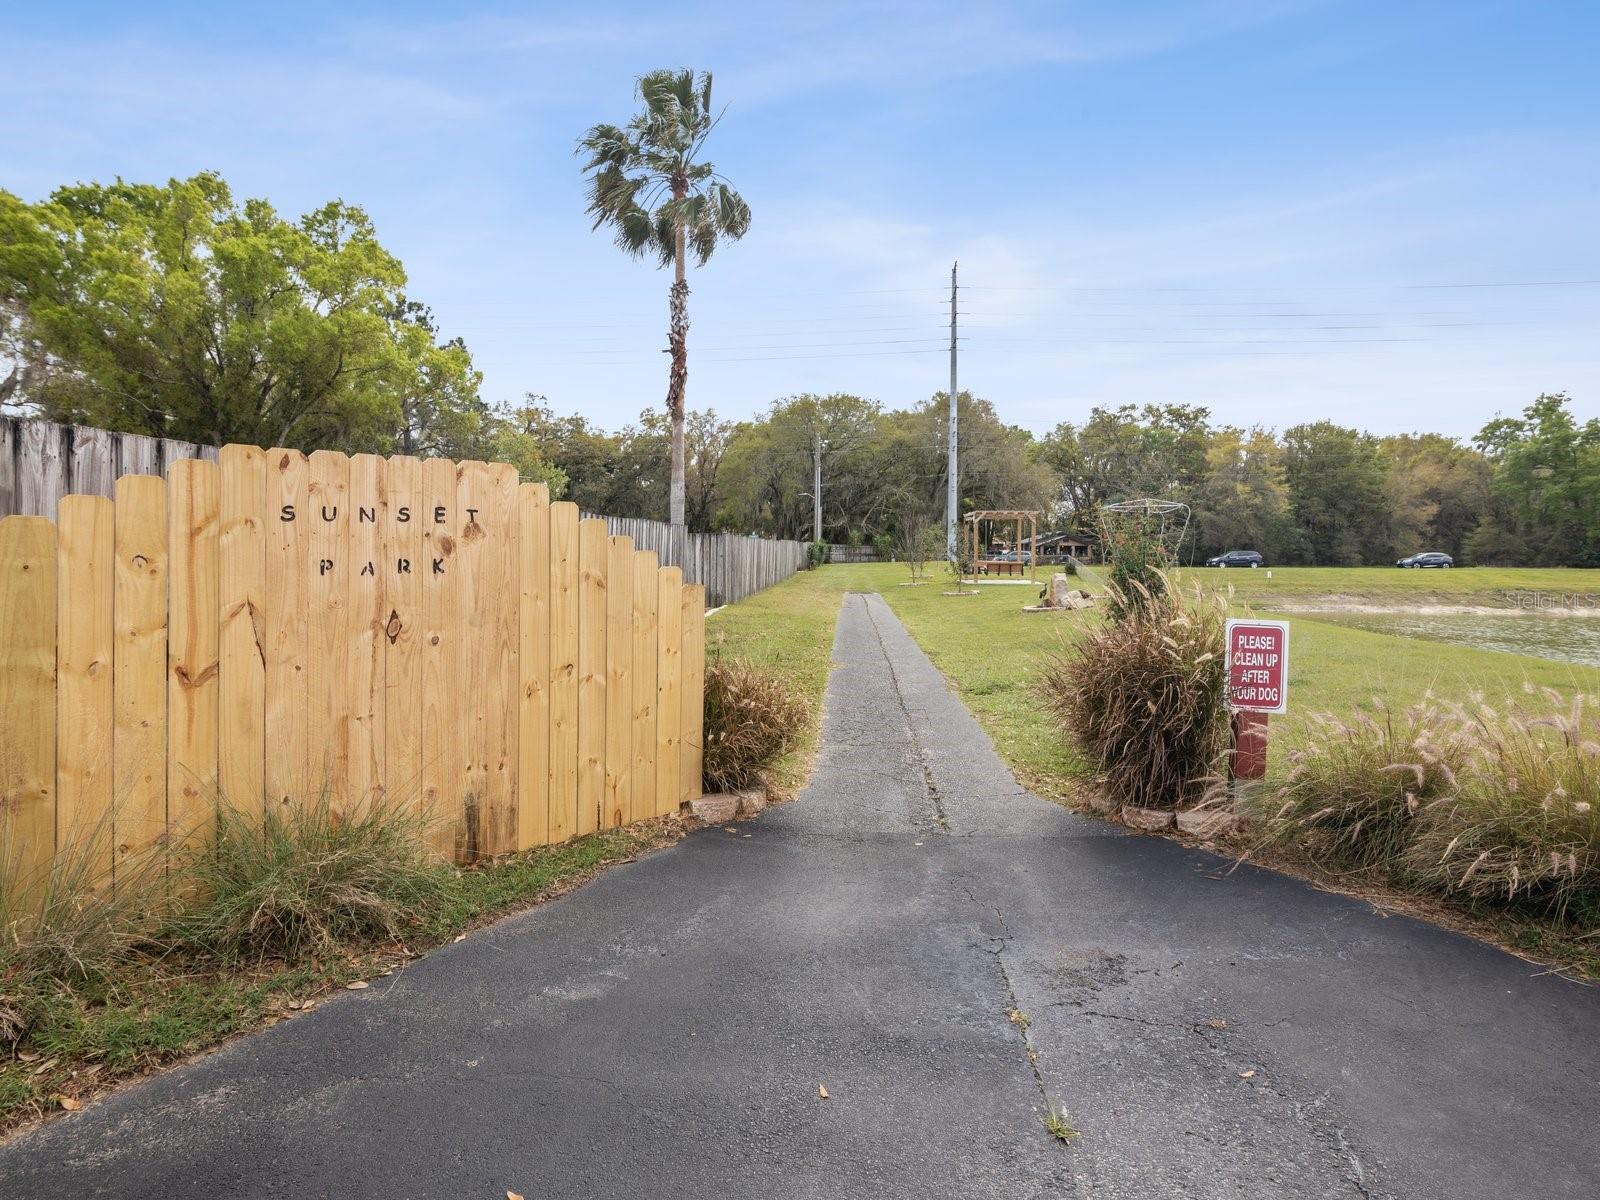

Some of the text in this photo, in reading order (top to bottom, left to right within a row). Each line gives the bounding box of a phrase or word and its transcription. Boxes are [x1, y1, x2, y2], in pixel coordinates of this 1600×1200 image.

[280, 505, 478, 523] SUNSET
[320, 558, 445, 576] PARK
[1239, 635, 1275, 649] PLEASE!
[1234, 652, 1278, 667] CLEAN UP
[1241, 670, 1269, 683] AFTER
[1258, 687, 1278, 701] DOG
